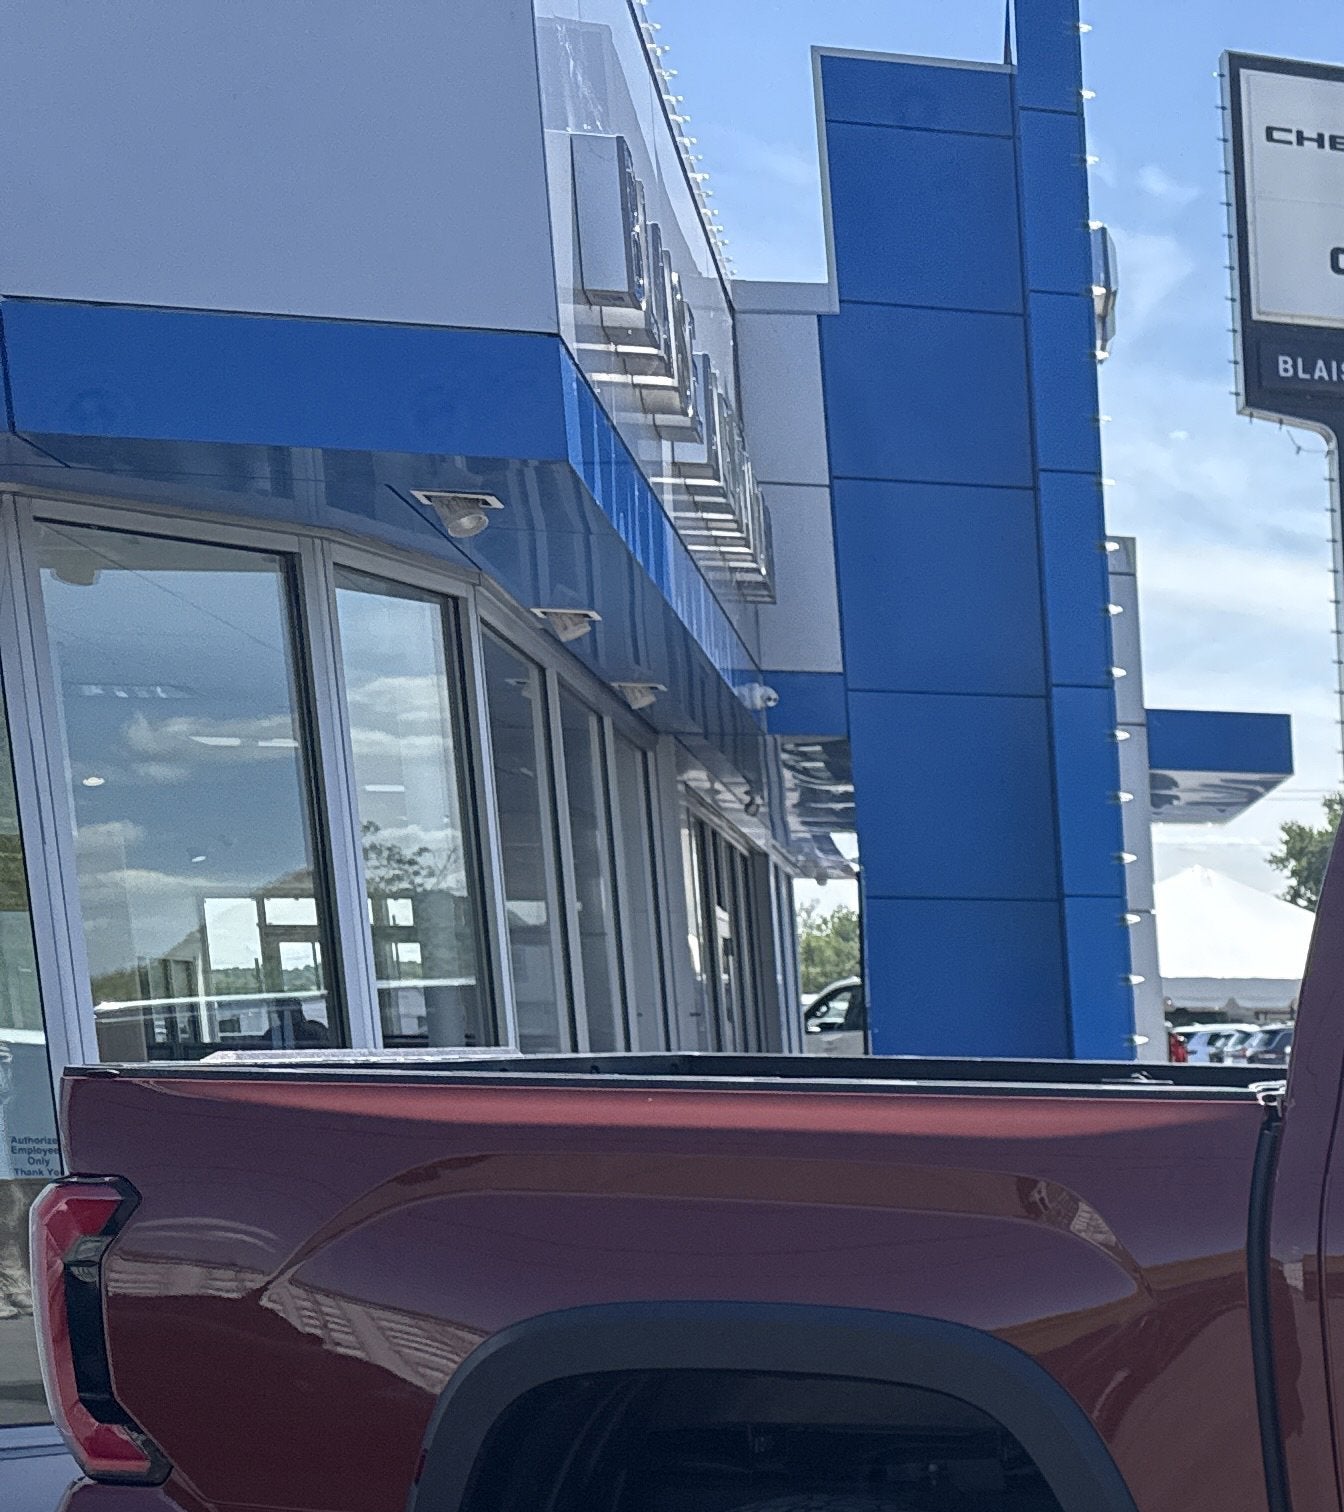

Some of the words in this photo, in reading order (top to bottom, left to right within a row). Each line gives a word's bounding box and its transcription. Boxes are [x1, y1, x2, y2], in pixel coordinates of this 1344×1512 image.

[10, 1136, 59, 1145] Authorize
[10, 1145, 60, 1157] Employee
[27, 1156, 50, 1167] Only
[13, 1167, 45, 1177] Thank
[46, 1167, 60, 1177] Yo
